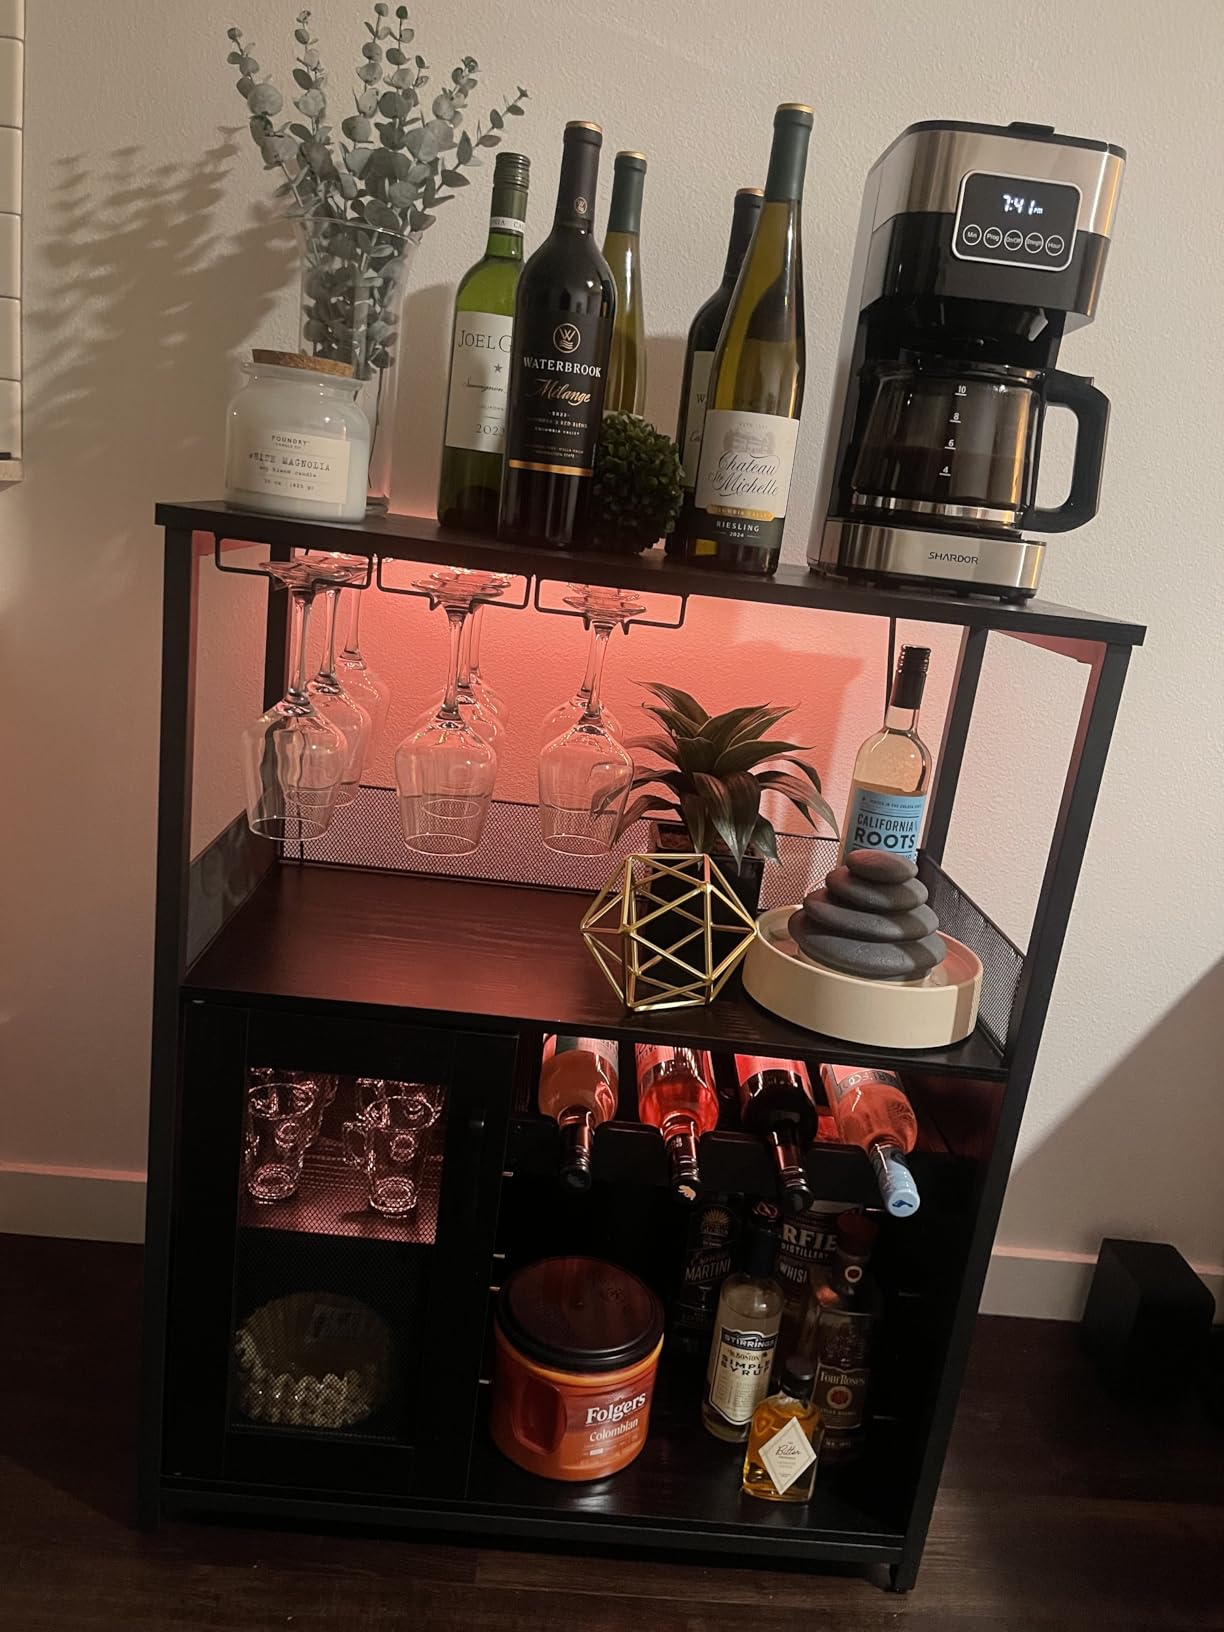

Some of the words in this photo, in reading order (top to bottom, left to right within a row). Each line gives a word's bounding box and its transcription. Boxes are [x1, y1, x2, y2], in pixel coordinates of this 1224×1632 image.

[967, 231, 978, 239] Min
[986, 233, 1000, 242] Prog
[458, 329, 496, 350] JOEL
[523, 356, 602, 378] WATERBROOK
[957, 385, 967, 394] 10
[953, 412, 960, 420] 8
[271, 435, 307, 446] FOUNDRY
[948, 439, 955, 447] 6
[282, 455, 331, 471] MAGNOLIA
[719, 451, 781, 476] Chateau
[713, 473, 779, 496] Michelle
[716, 520, 760, 533] RIESLING
[928, 551, 979, 565] SHARDOR
[857, 813, 914, 832] CALIFORNIA
[854, 826, 916, 849] ROOTS
[685, 1257, 732, 1281] MARTINI
[585, 1393, 647, 1424] Folgers
[590, 1417, 639, 1442] Colombian
